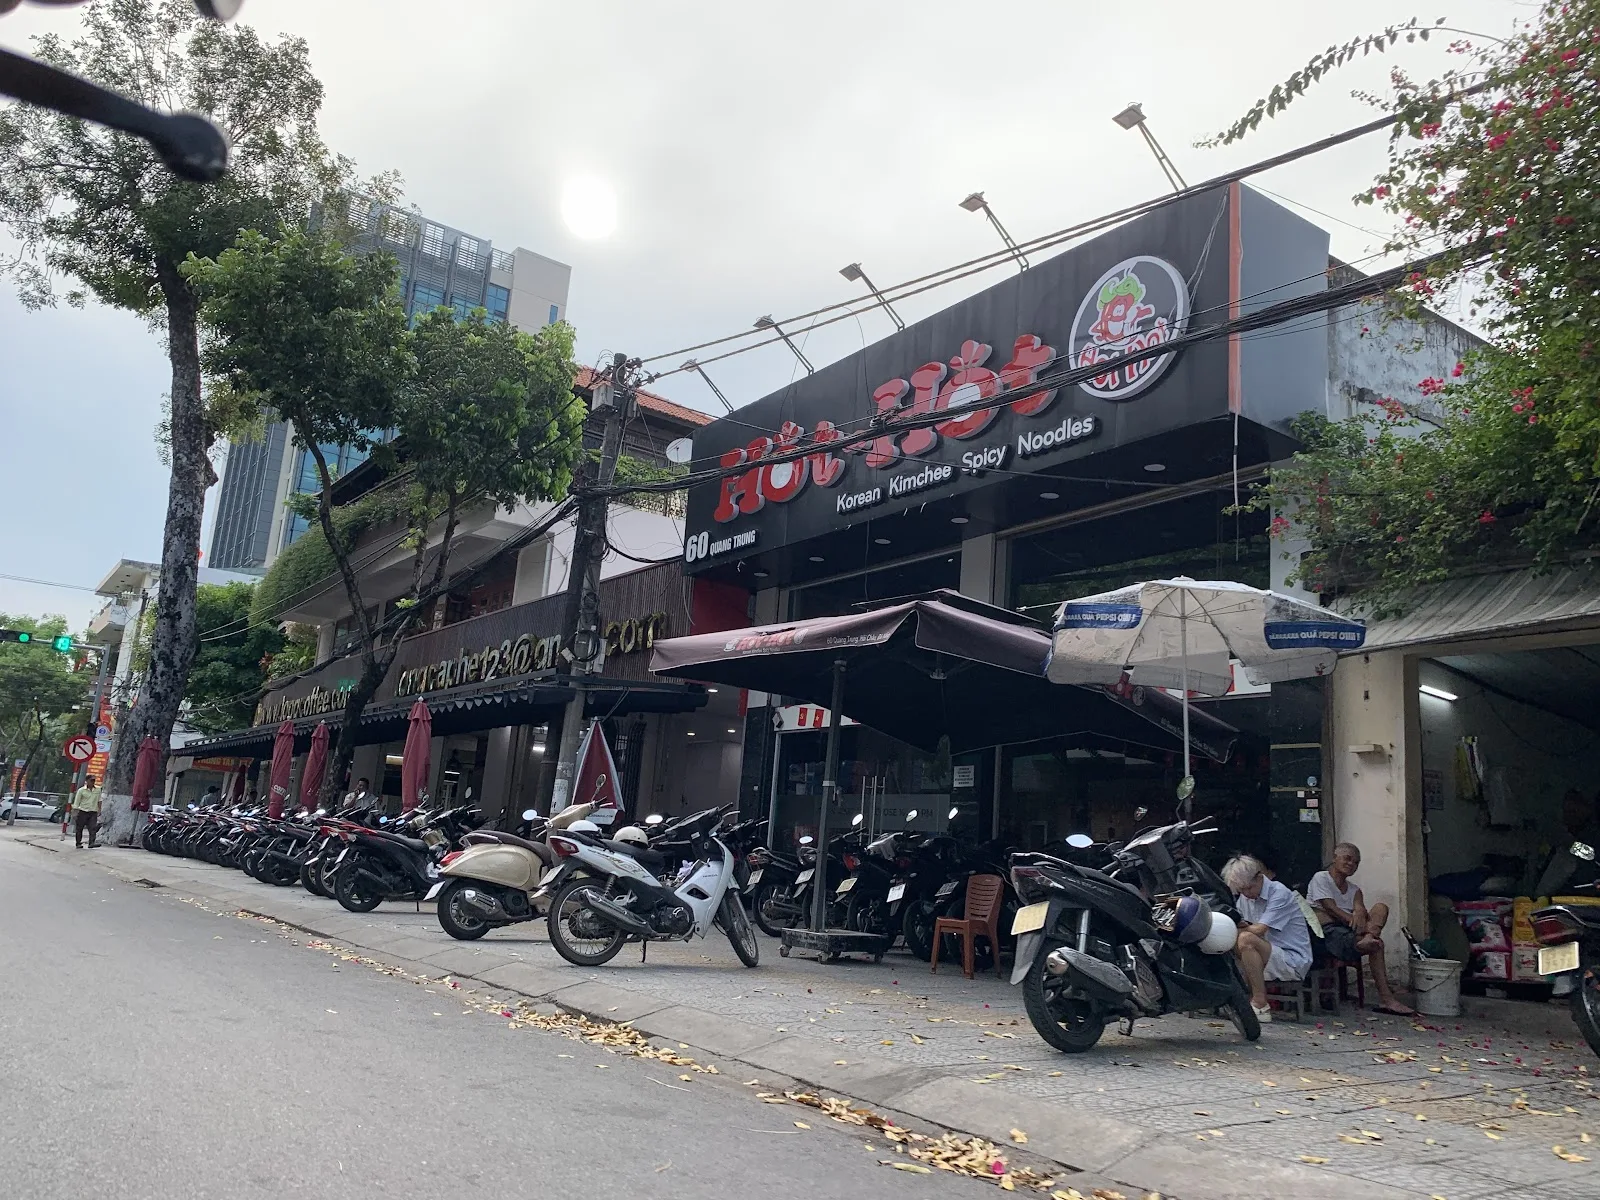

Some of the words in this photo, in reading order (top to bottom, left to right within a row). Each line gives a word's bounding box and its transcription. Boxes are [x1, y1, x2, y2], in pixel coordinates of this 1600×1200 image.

[836, 486, 882, 512] Korean
[888, 465, 952, 497] Kimchee
[961, 446, 1007, 475] Spicy
[1017, 417, 1093, 455] Noodles
[685, 531, 709, 562] 60
[709, 537, 732, 556] QUANG
[733, 530, 756, 549] TRUNG
[1095, 613, 1117, 622] PEPSI
[833, 635, 847, 645] Quang
[1318, 631, 1338, 640] PEPSI
